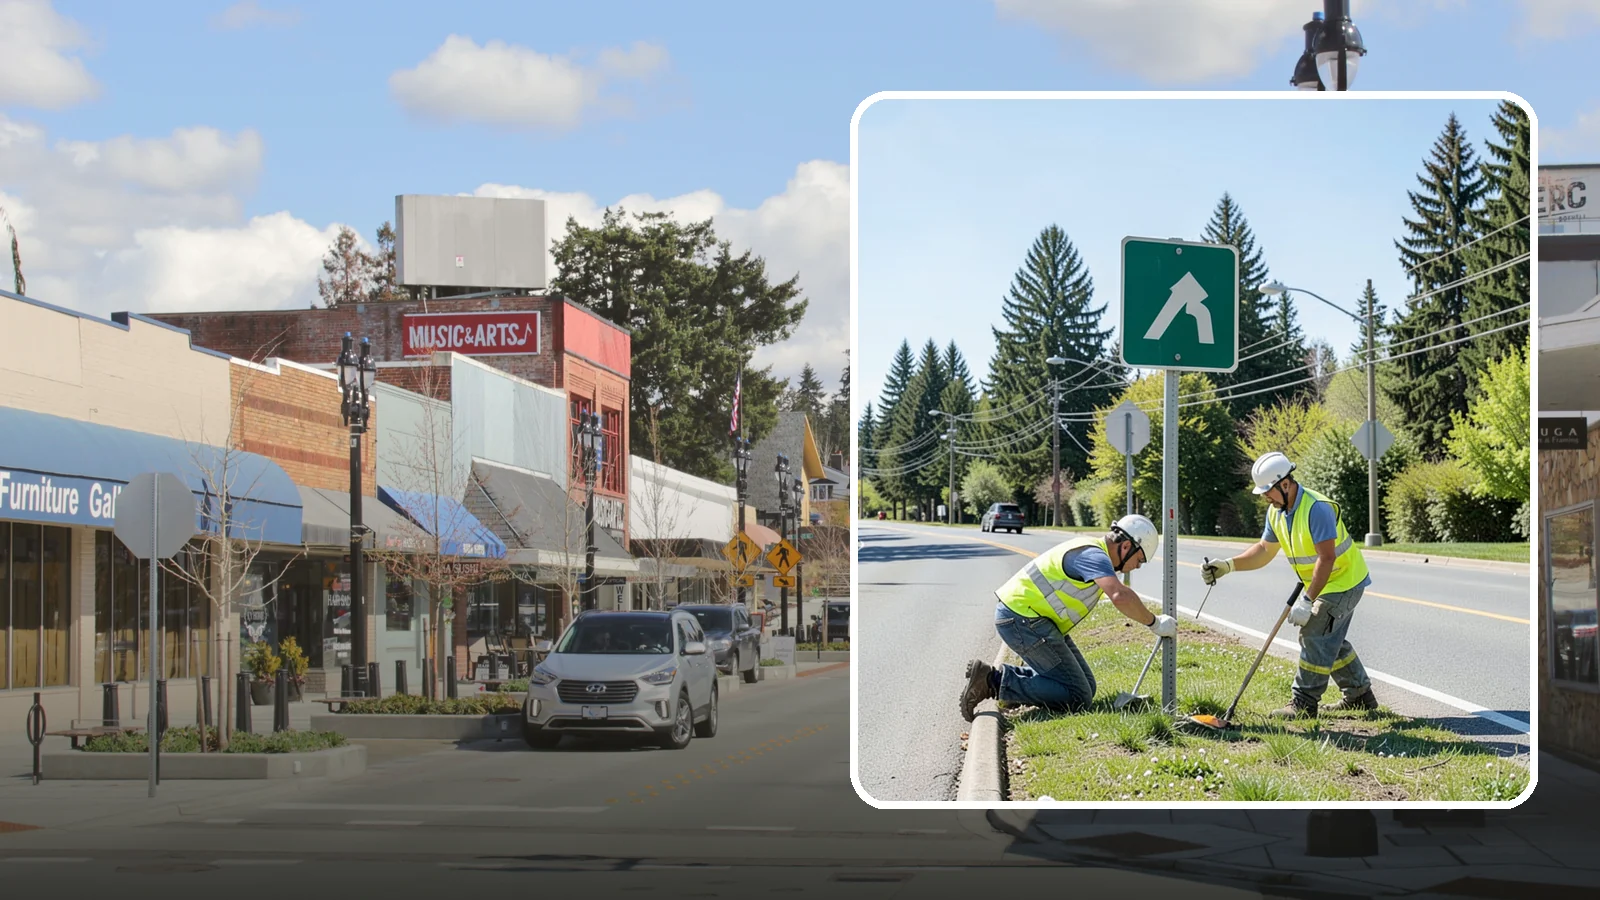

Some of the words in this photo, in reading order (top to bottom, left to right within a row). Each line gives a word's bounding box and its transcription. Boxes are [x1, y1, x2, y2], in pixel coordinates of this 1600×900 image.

[0, 472, 79, 515] Furniture
[89, 482, 122, 519] Gal
[453, 563, 479, 574] SUSHI
